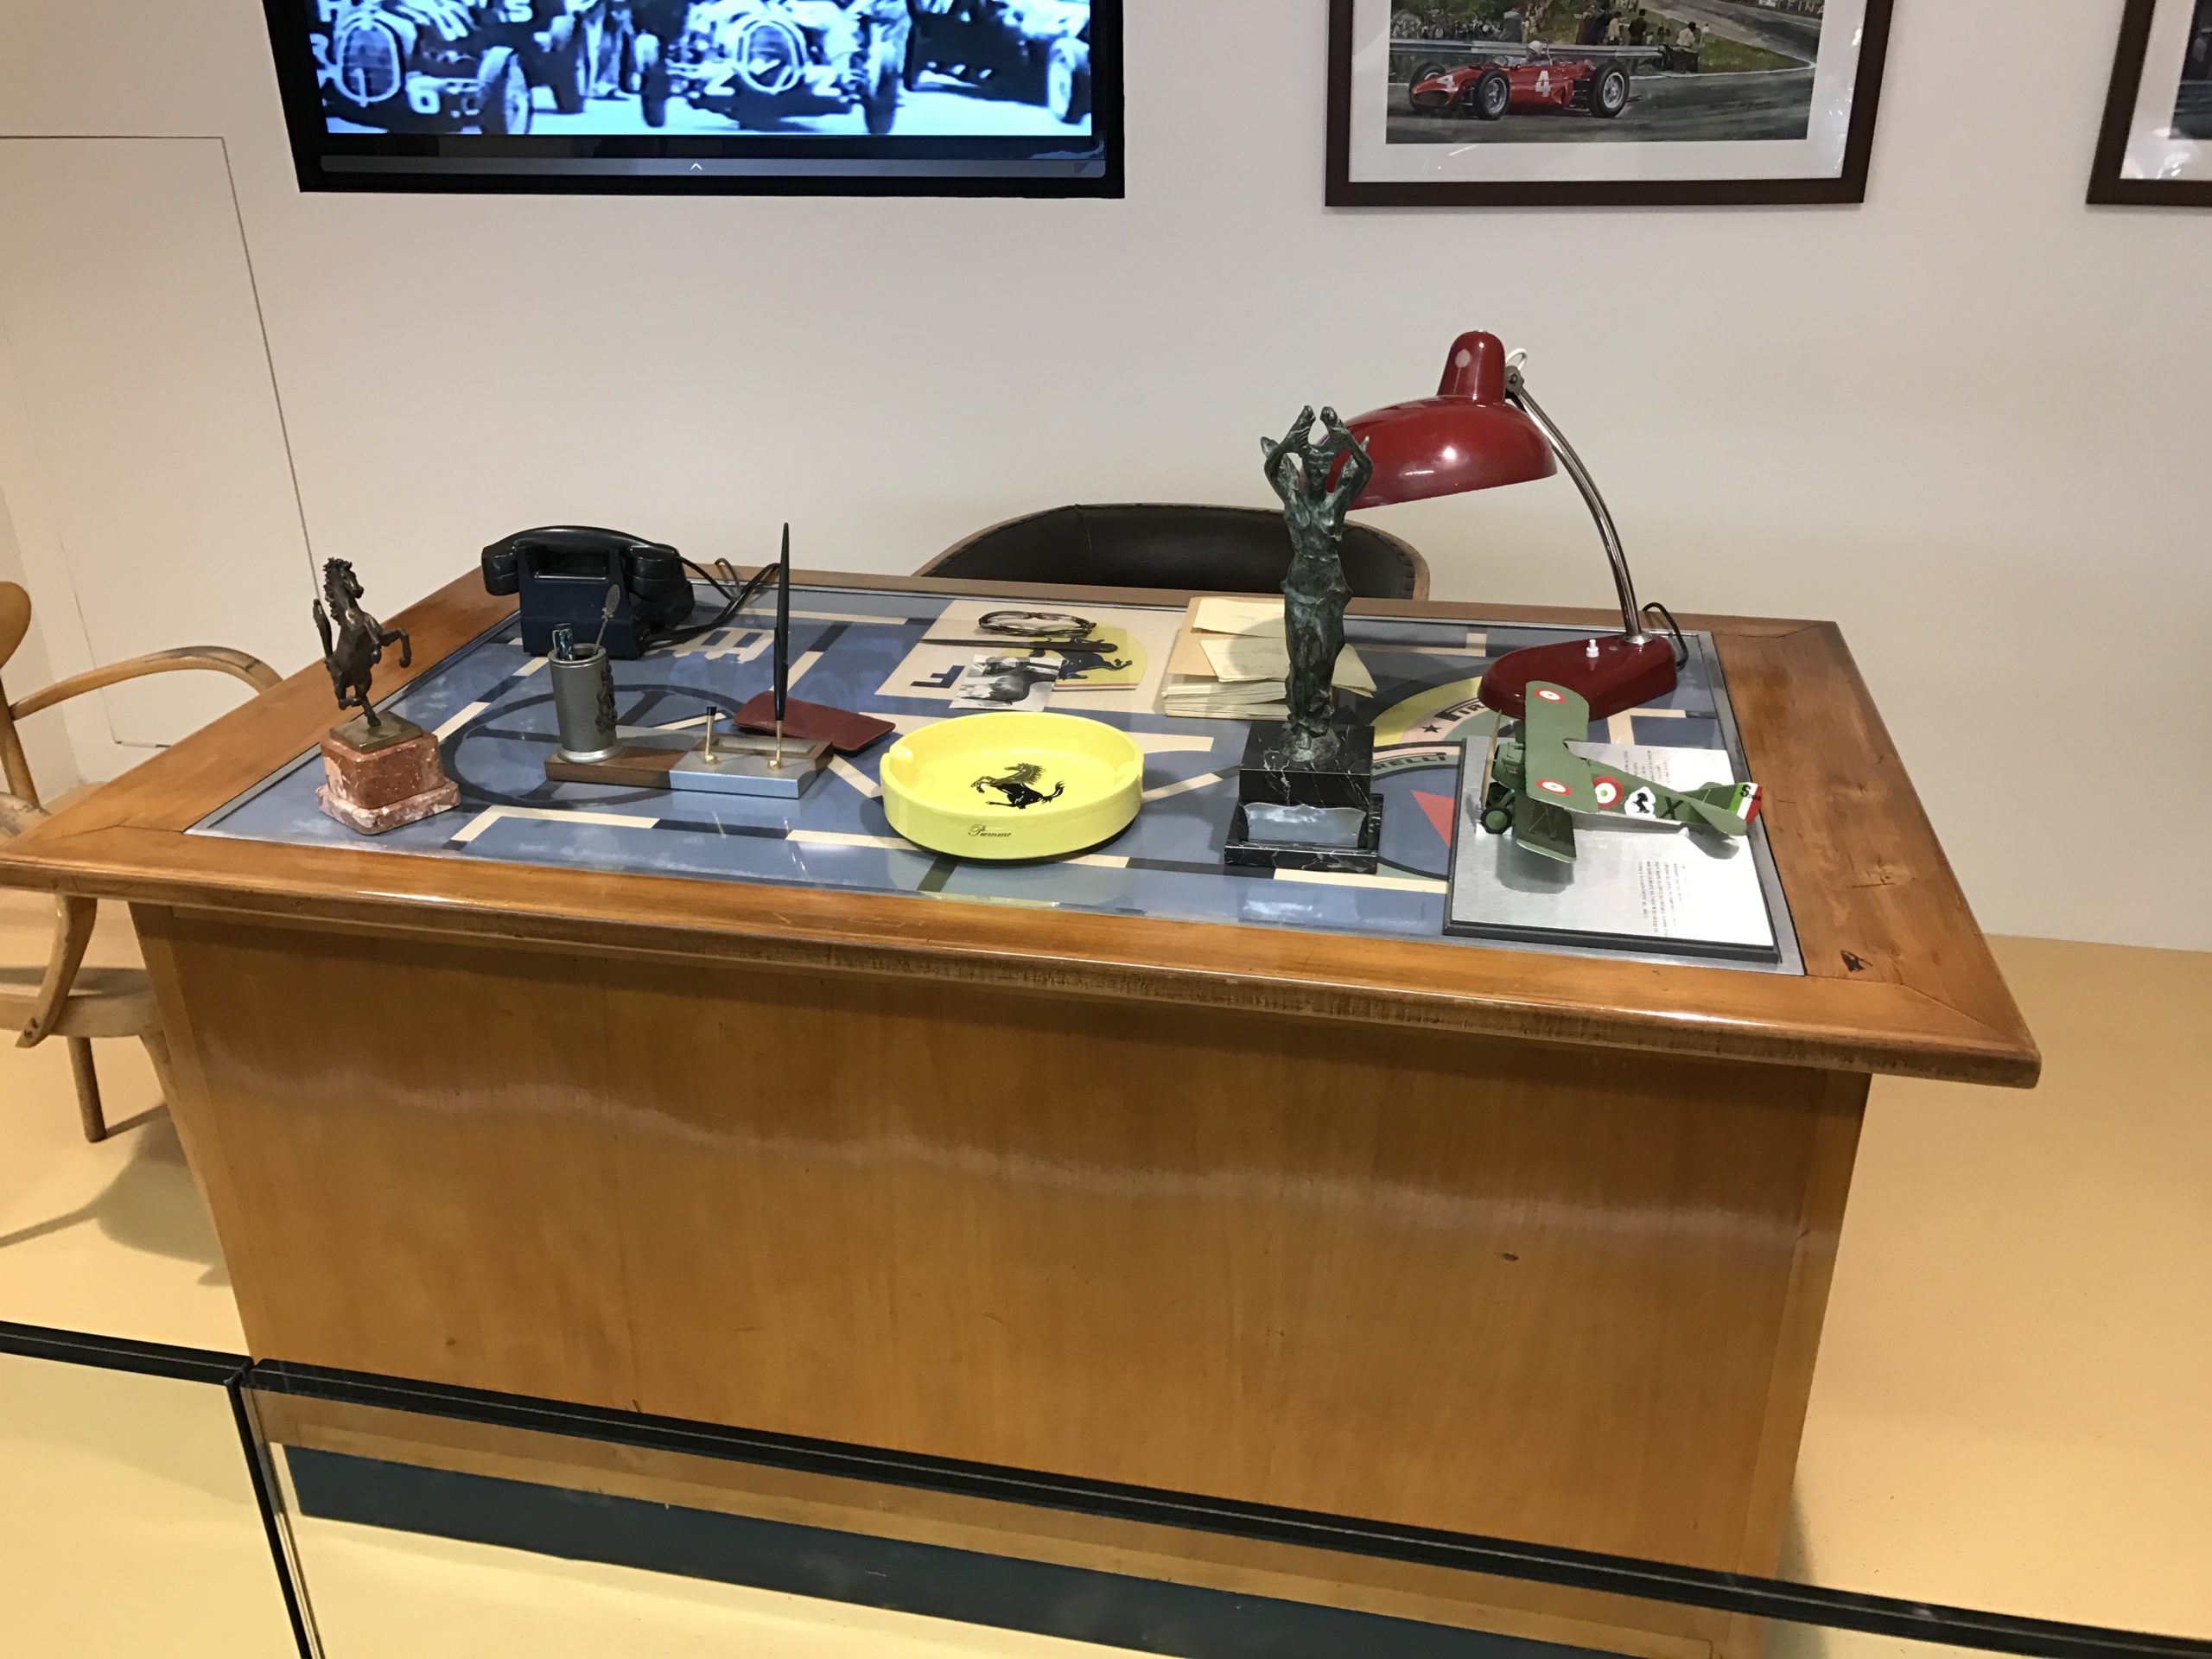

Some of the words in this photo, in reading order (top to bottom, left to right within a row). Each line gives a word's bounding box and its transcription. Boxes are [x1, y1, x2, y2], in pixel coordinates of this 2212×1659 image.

[1534, 70, 1552, 98] 4
[1659, 796, 1685, 820] X
[968, 823, 1012, 837] Piemme
